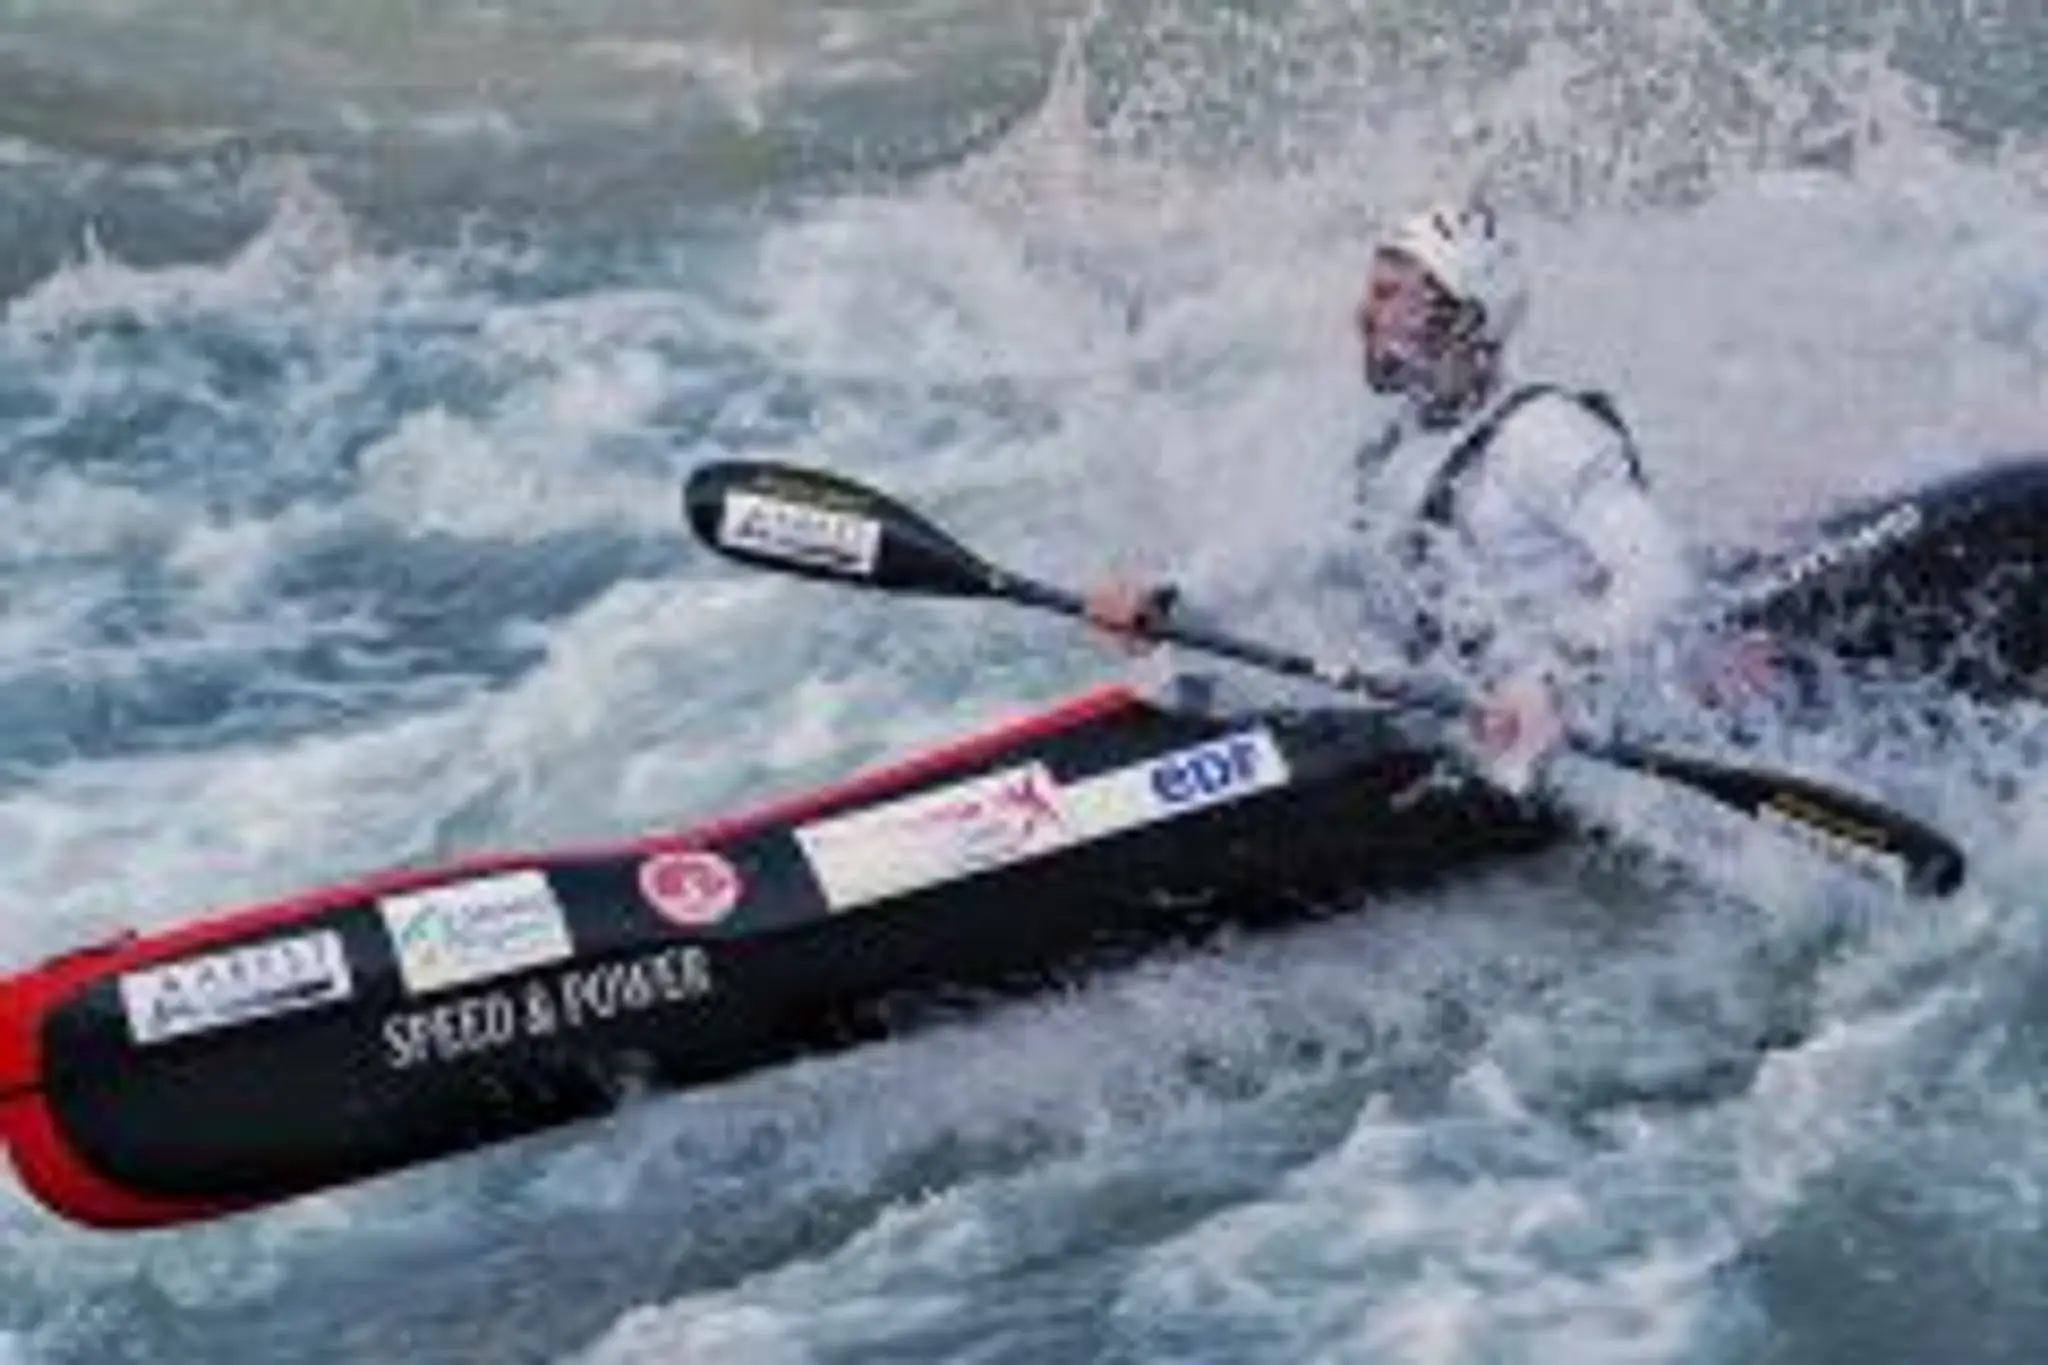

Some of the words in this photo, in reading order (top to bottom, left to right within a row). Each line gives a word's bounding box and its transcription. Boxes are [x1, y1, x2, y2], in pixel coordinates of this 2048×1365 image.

[383, 992, 514, 1069] SPEED
[523, 979, 556, 1035] &
[562, 946, 711, 1026] POWER
